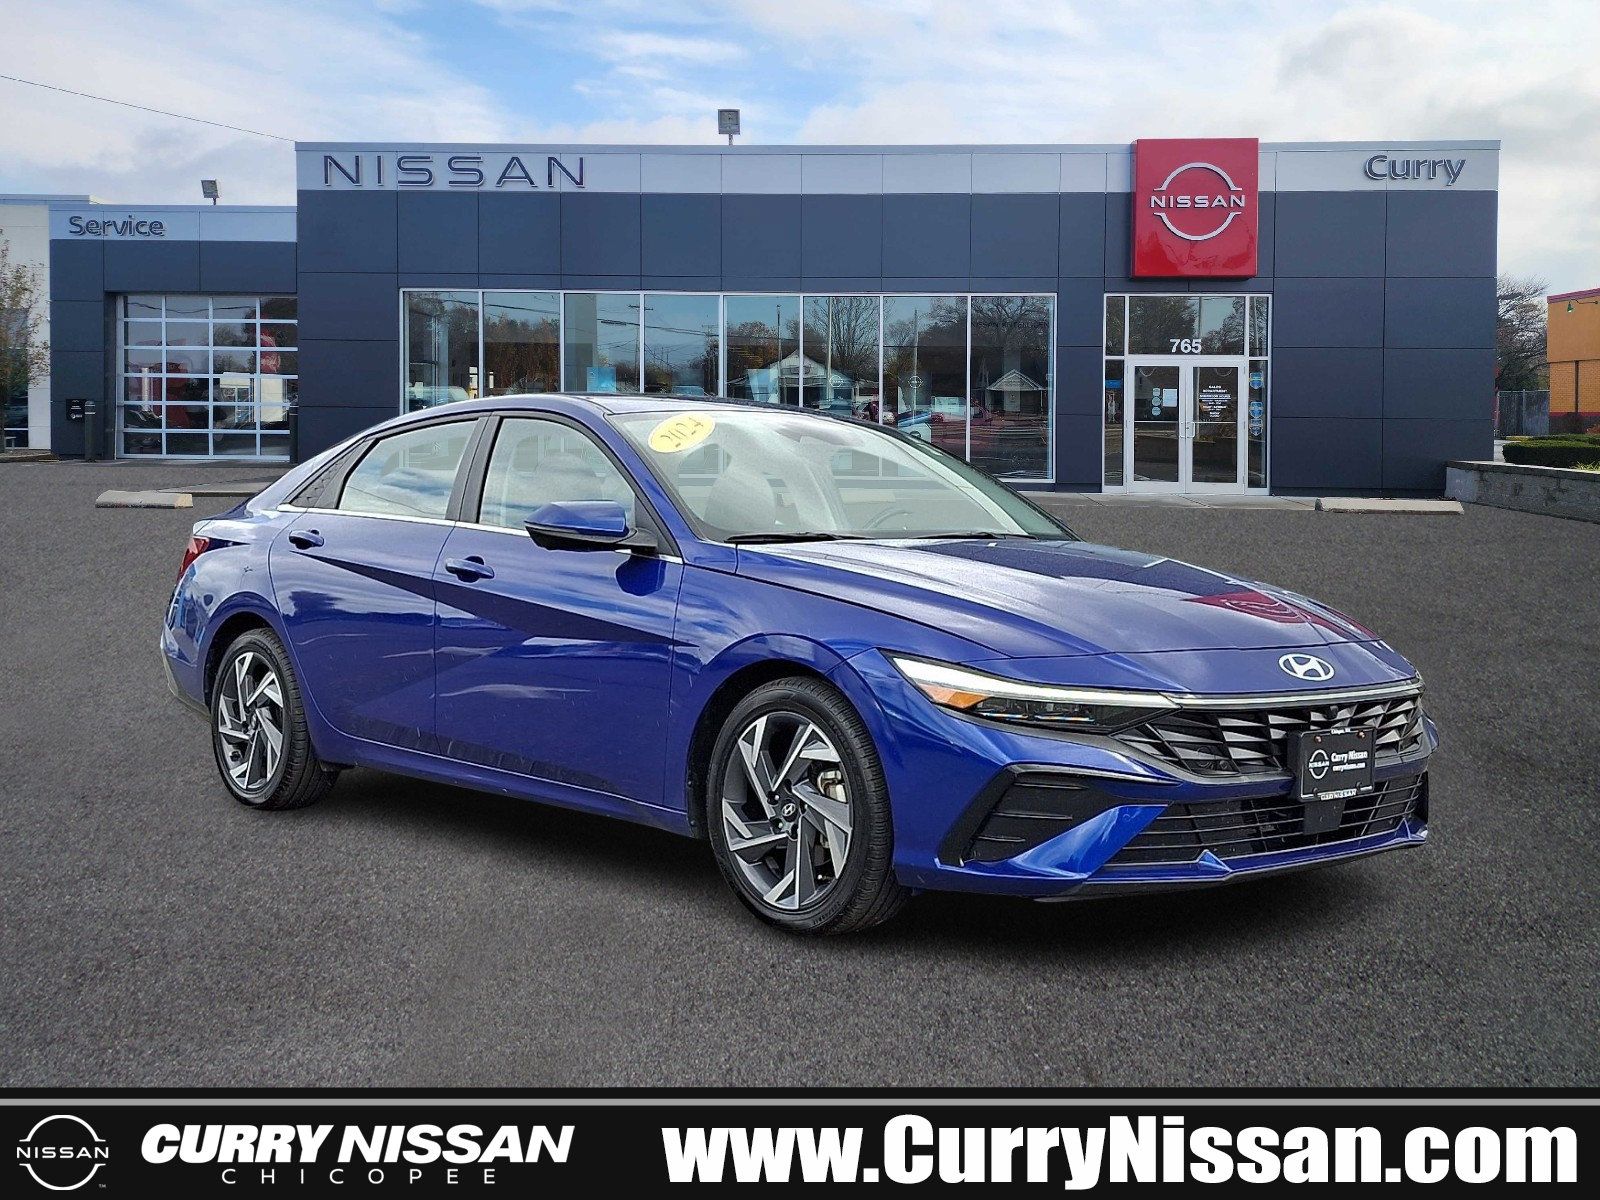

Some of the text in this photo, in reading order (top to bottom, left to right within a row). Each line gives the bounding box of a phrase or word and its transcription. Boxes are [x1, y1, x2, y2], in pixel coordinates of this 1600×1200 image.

[323, 154, 585, 189] NISSAN
[1365, 154, 1466, 187] Curry
[1150, 194, 1246, 209] NISSAN
[68, 214, 165, 237] Service
[1169, 338, 1202, 353] 765
[1331, 750, 1368, 763] Curry Nissan
